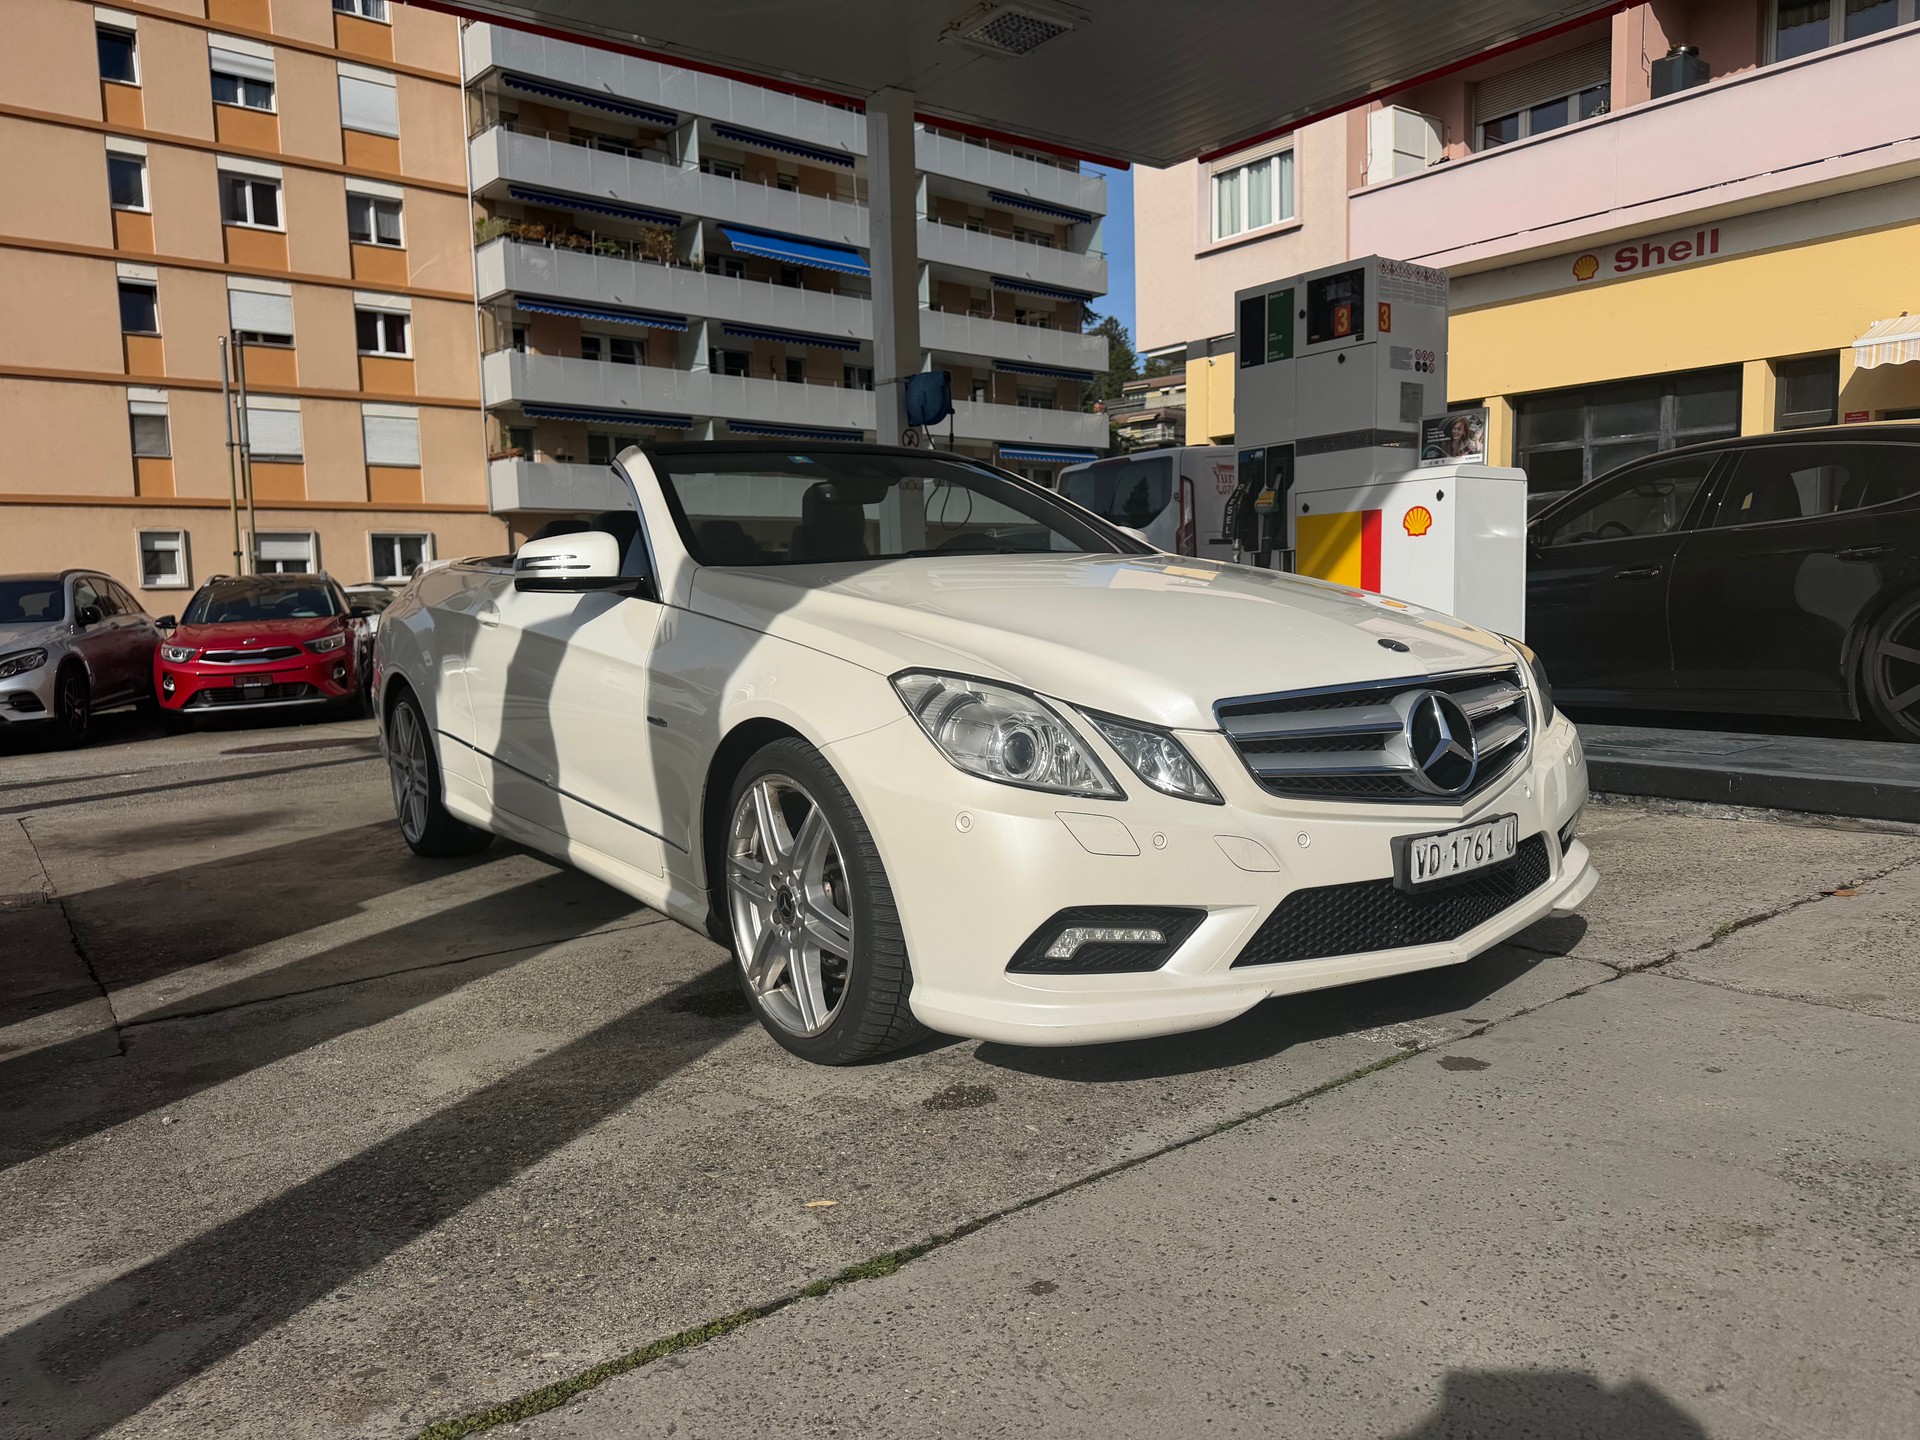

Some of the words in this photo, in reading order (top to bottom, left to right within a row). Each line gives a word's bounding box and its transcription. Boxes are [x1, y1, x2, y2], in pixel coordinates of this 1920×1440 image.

[1614, 229, 1720, 273] Shell
[1337, 307, 1350, 332] 3
[1379, 305, 1390, 331] 3
[1225, 483, 1245, 534] DIESEL
[1416, 844, 1440, 879] VD
[1451, 829, 1494, 871] 1761
[1504, 818, 1516, 855] U
